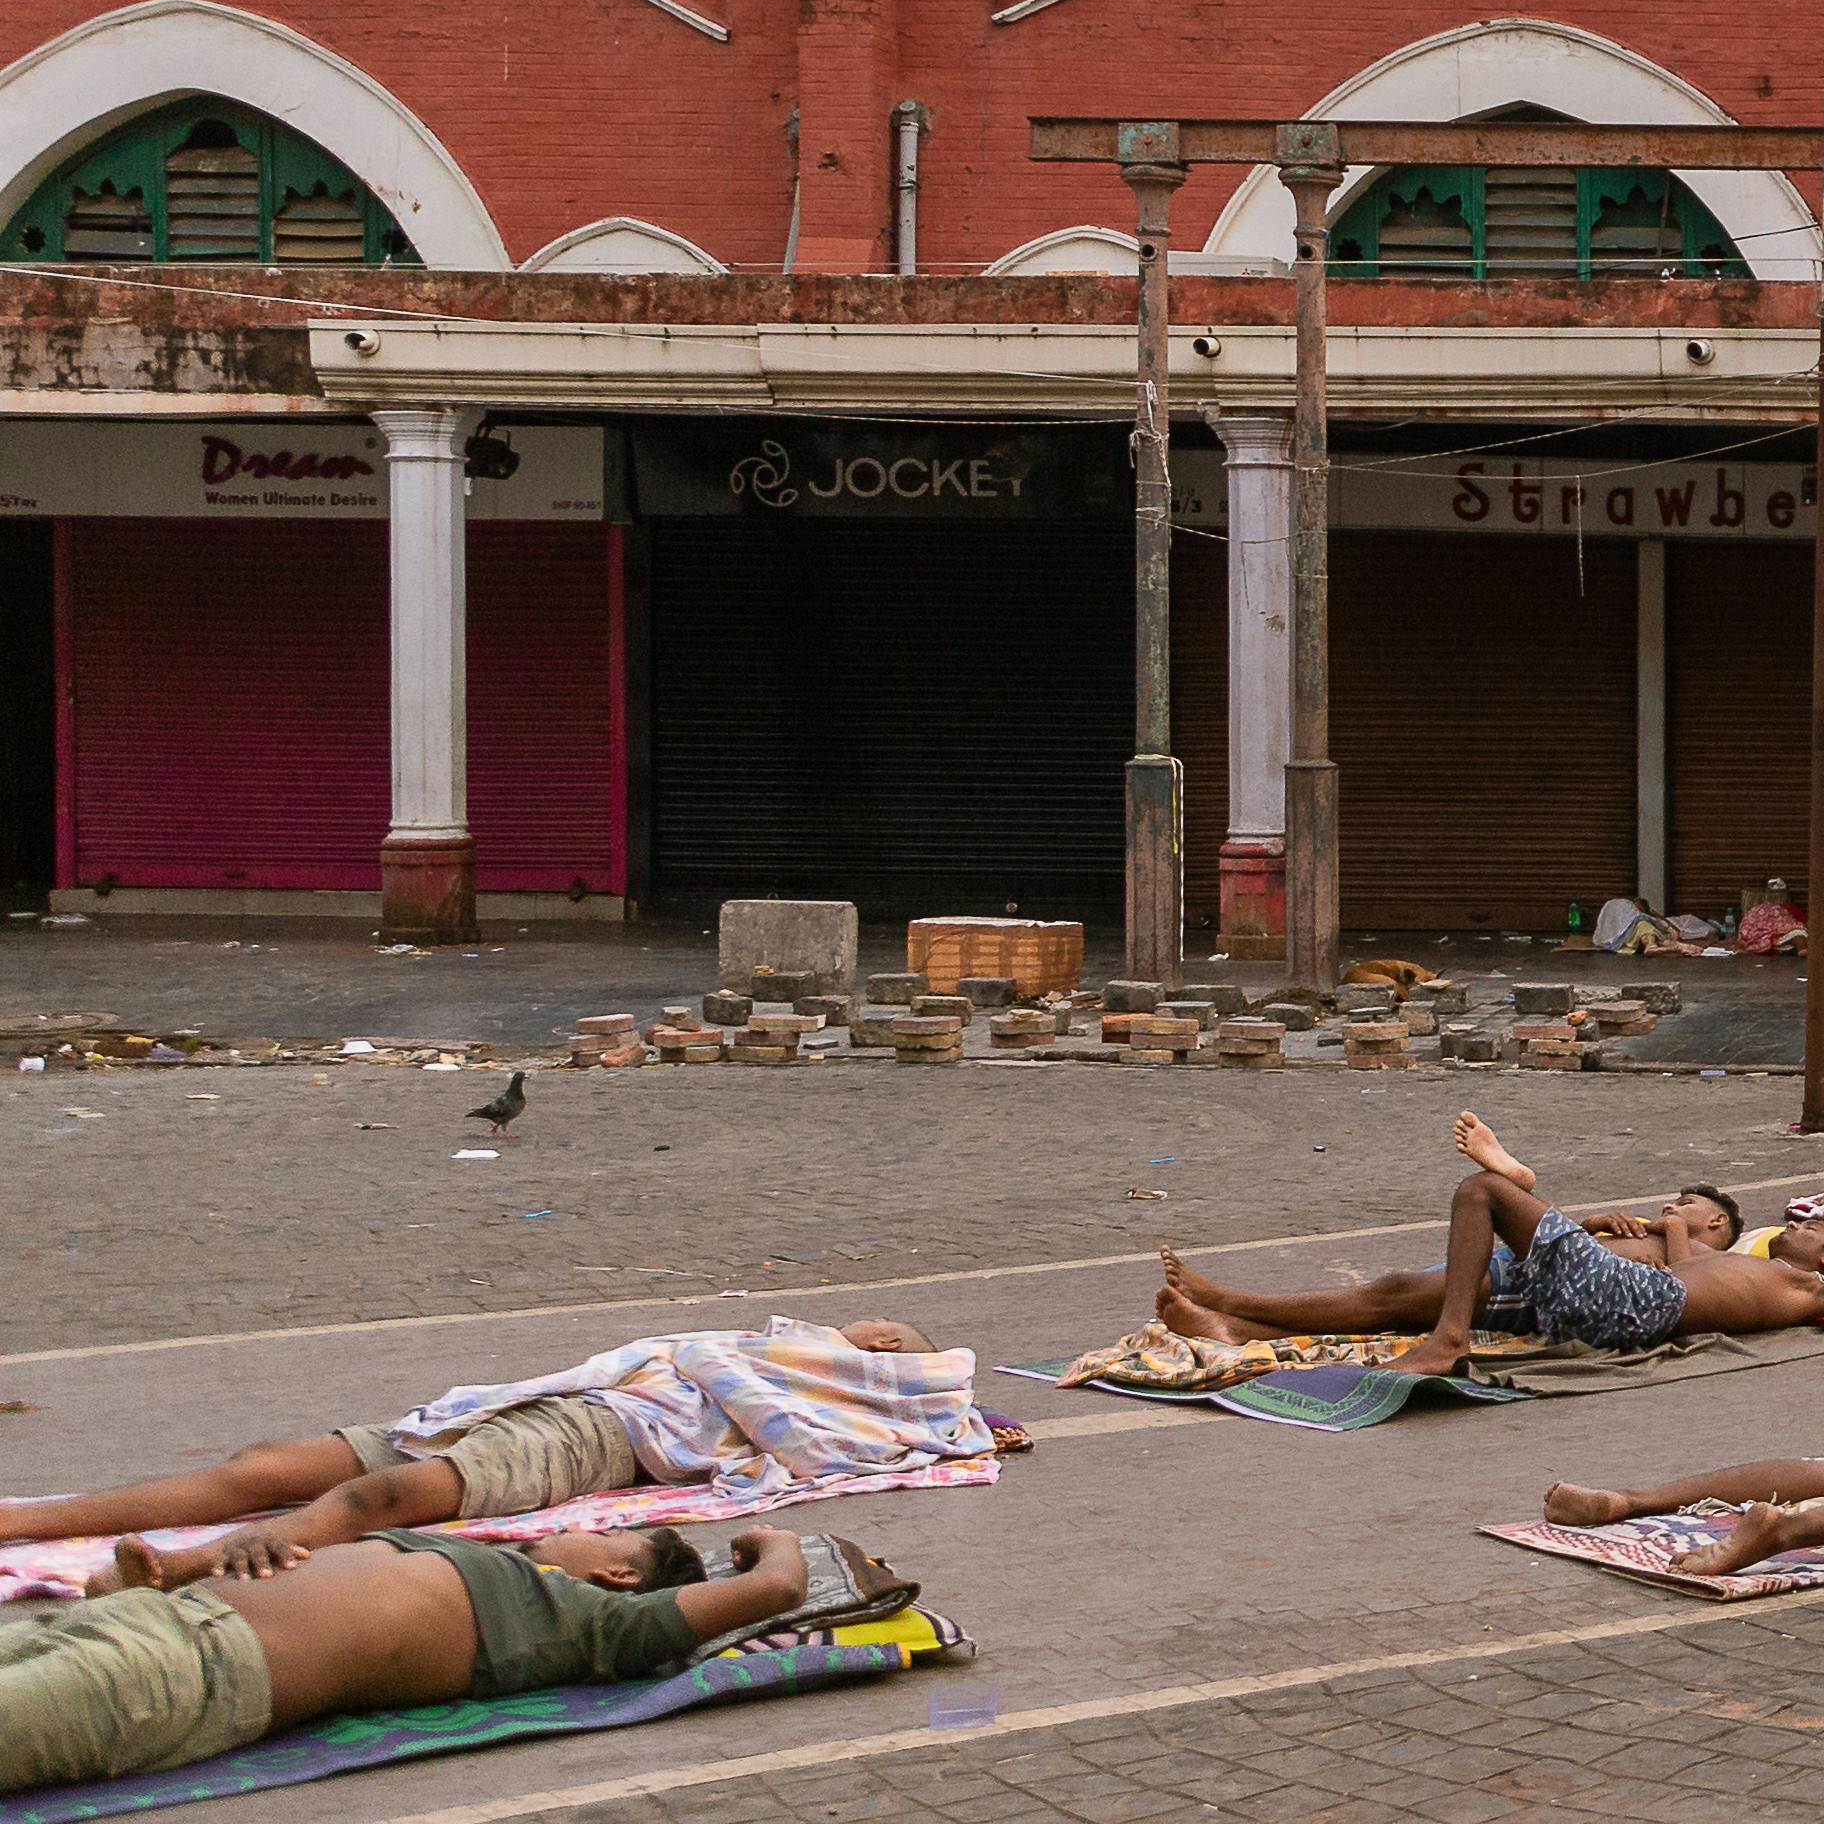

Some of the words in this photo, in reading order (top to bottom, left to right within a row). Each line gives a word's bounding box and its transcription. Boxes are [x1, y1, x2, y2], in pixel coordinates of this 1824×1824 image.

[809, 457, 1022, 497] JOCKEY
[206, 491, 258, 505] Women
[263, 491, 325, 506] Ultimate
[331, 493, 377, 506] Desire
